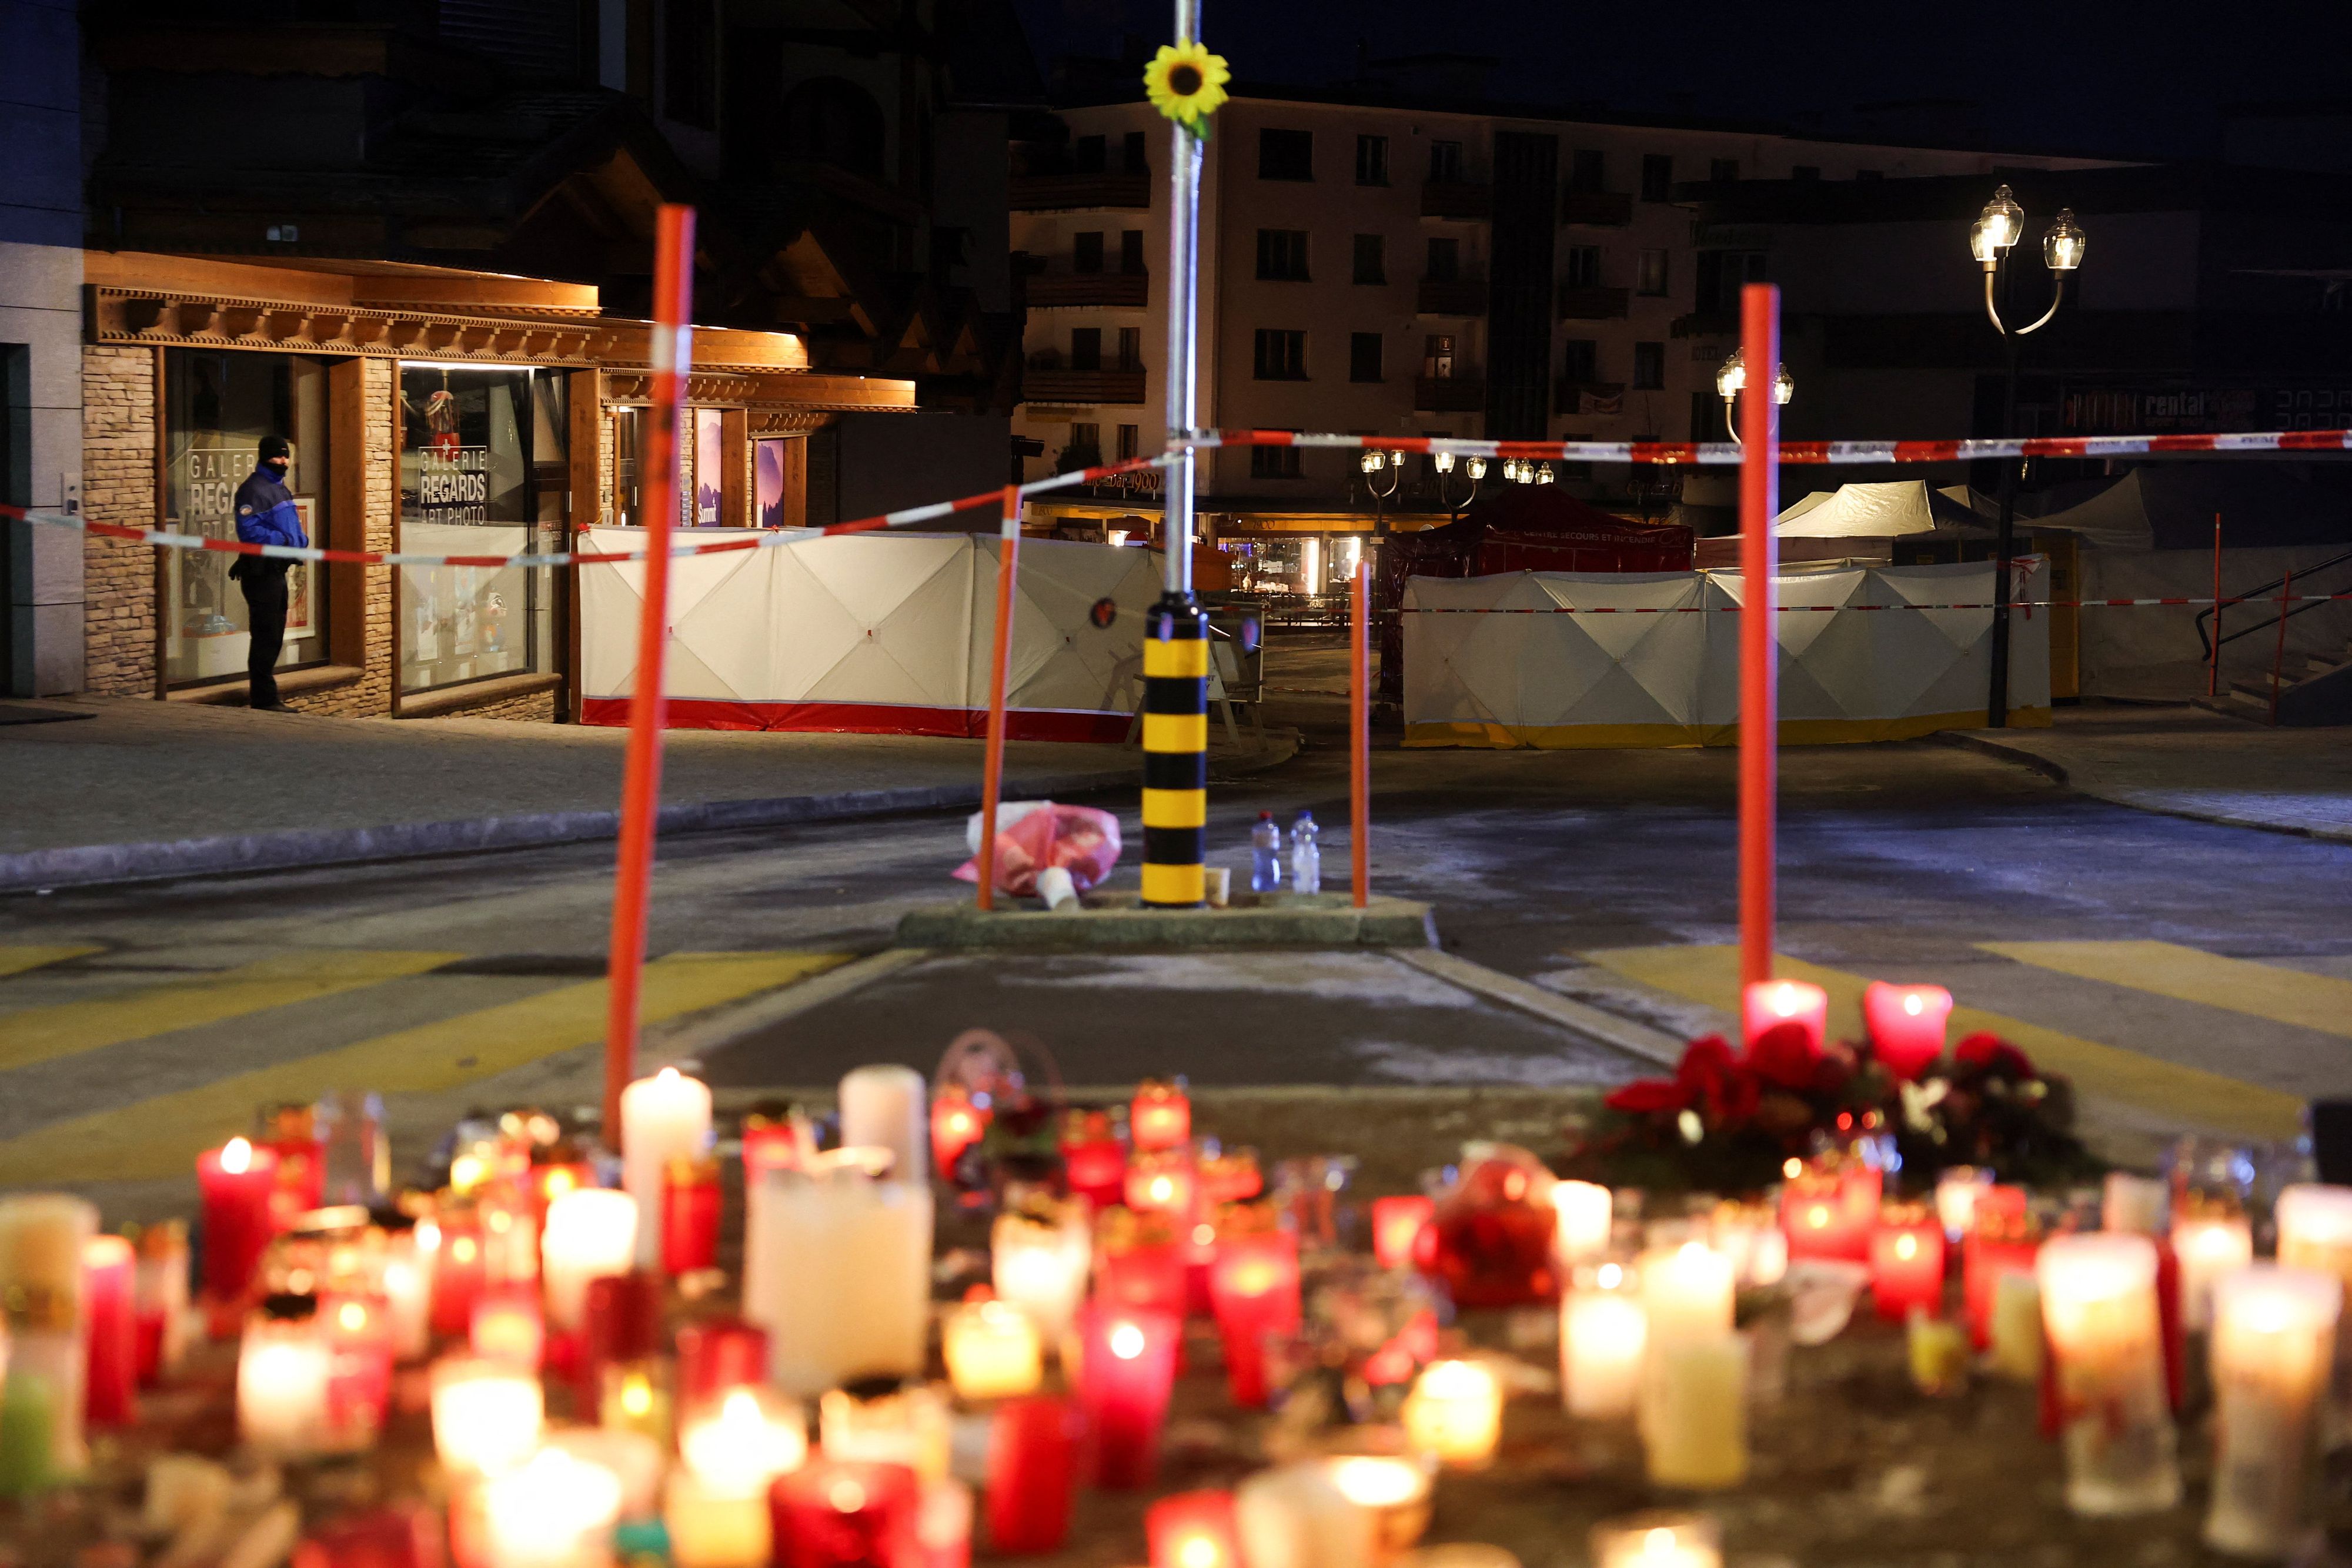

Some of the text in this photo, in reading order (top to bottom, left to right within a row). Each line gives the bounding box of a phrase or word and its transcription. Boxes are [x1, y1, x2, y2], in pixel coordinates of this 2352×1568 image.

[2144, 391, 2204, 416] rental
[190, 454, 255, 478] GALER
[420, 451, 485, 472] GALERIE
[420, 473, 485, 504] REGARDS
[1130, 472, 1159, 493] 1900
[191, 482, 238, 514] REGA
[422, 505, 485, 526] ART PHOTO
[1524, 531, 1558, 539] CENTRE
[1560, 531, 1599, 541] SECOURS
[1601, 533, 1612, 541] ET
[1614, 534, 1656, 544] INCENDIE
